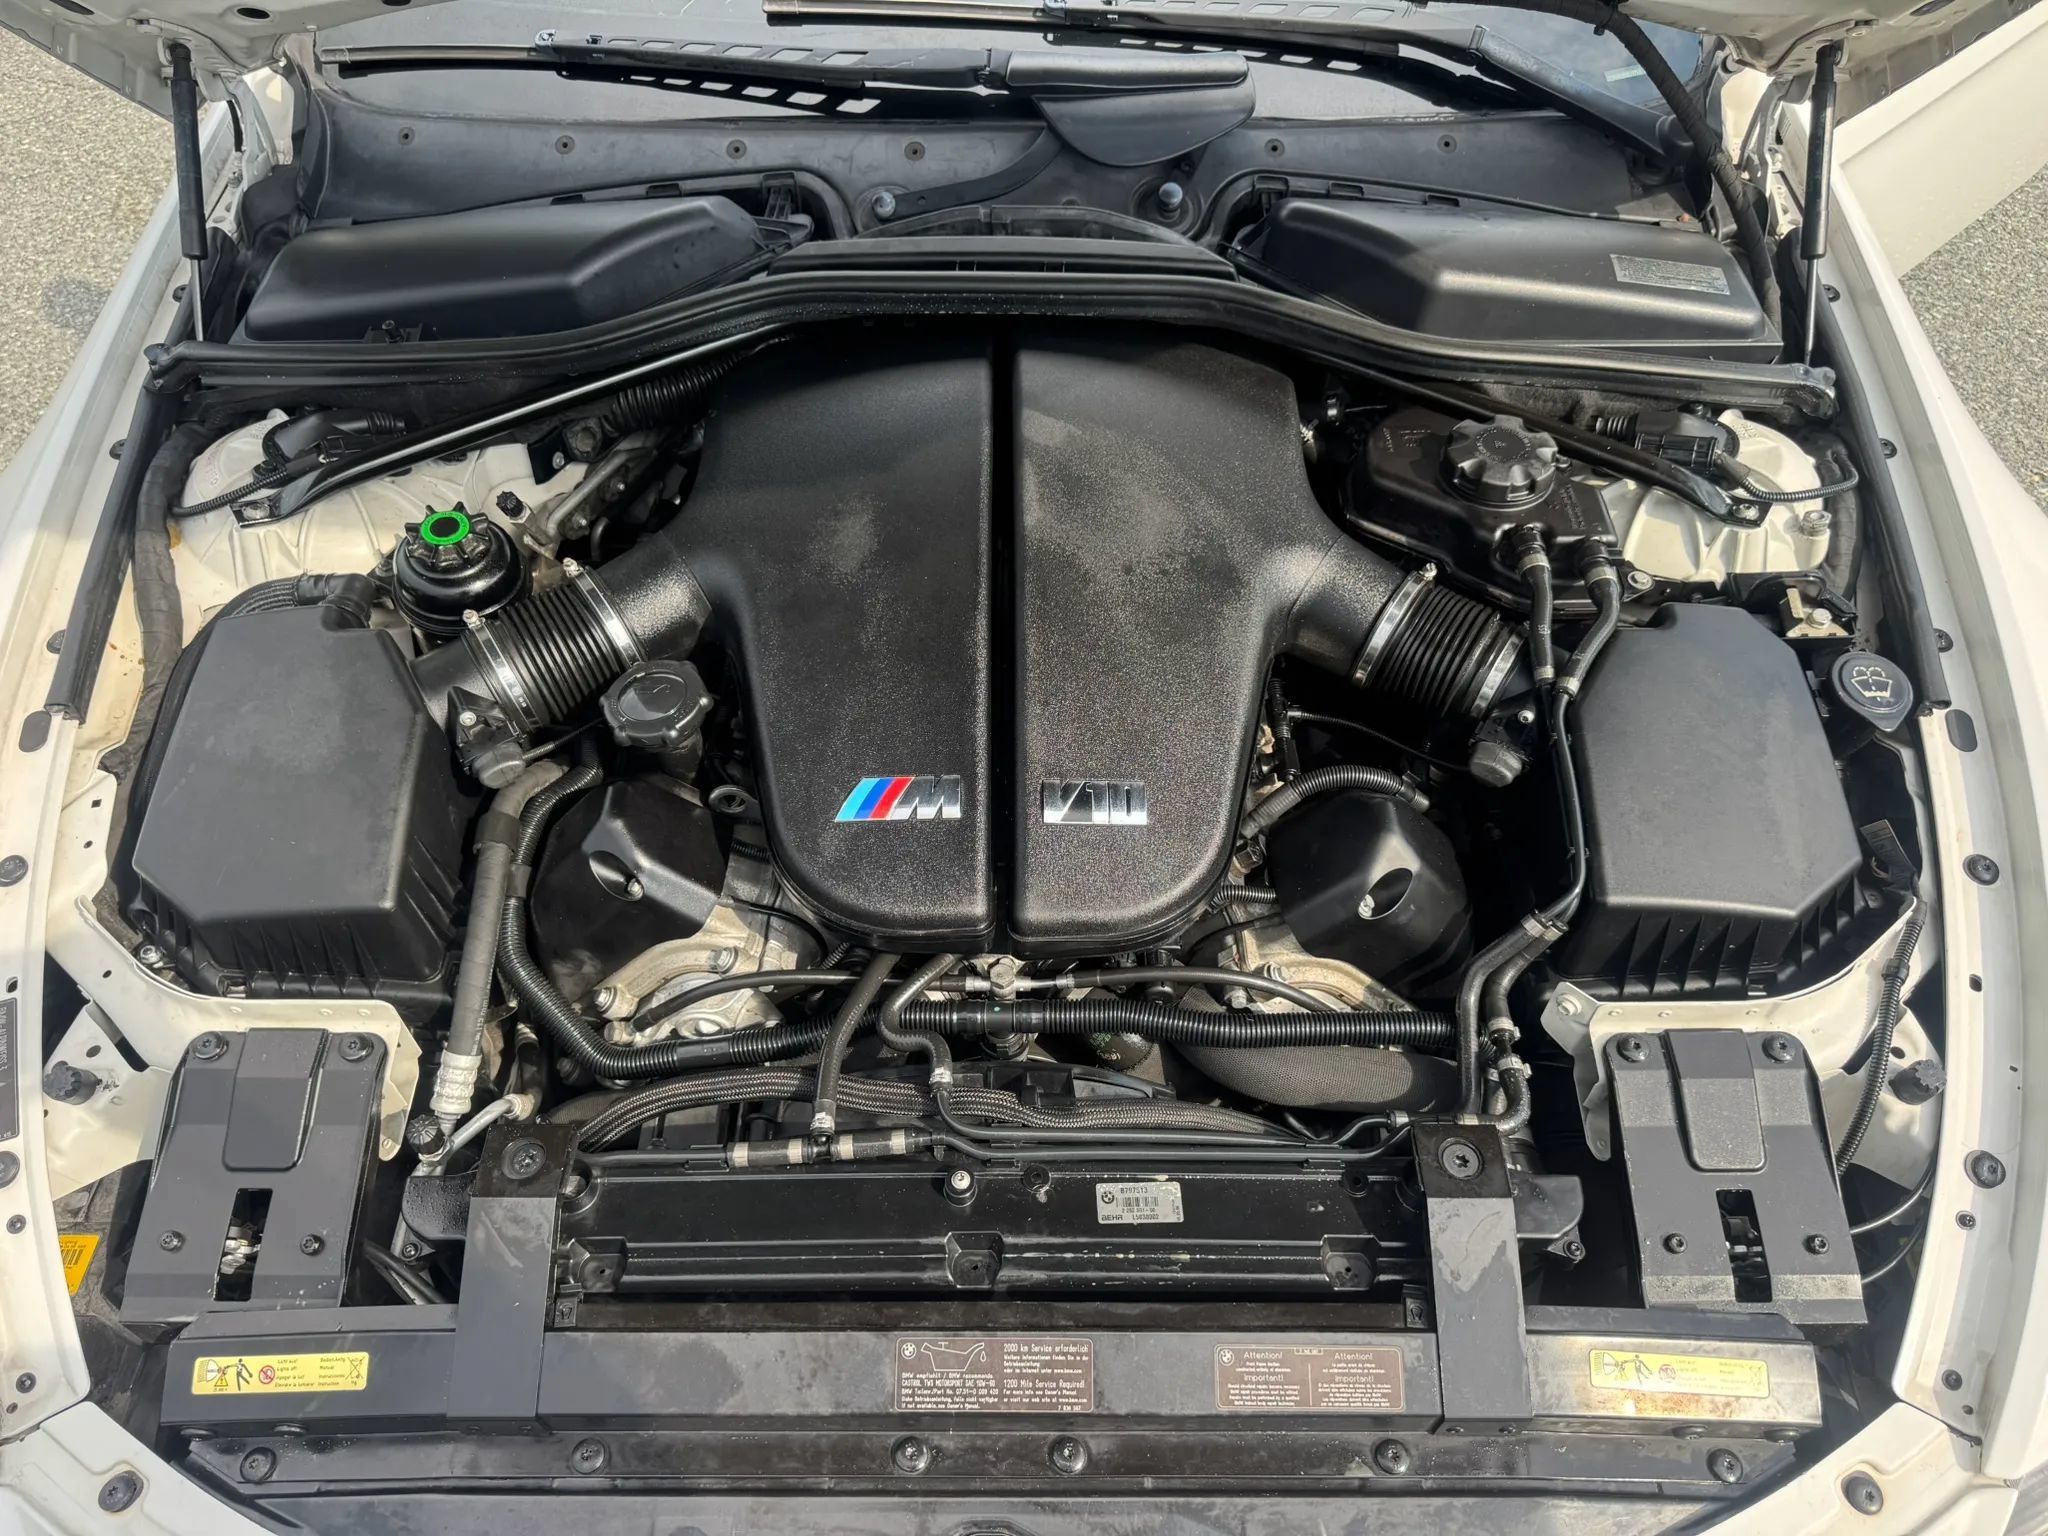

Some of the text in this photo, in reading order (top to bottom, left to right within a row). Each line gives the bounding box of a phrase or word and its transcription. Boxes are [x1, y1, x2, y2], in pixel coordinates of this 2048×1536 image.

[886, 774, 961, 820] M
[1043, 778, 1148, 825] V10
[1003, 1343, 1018, 1352] 2000
[1020, 1343, 1029, 1352] km
[1031, 1343, 1052, 1352] Service
[1243, 1351, 1283, 1360] Attention!
[1334, 1352, 1373, 1361] Attention!
[1243, 1374, 1284, 1382] Important!
[1335, 1375, 1374, 1383] Important!
[1003, 1379, 1018, 1388] 1200
[1020, 1379, 1033, 1388] Mile
[1035, 1379, 1057, 1388] Service
